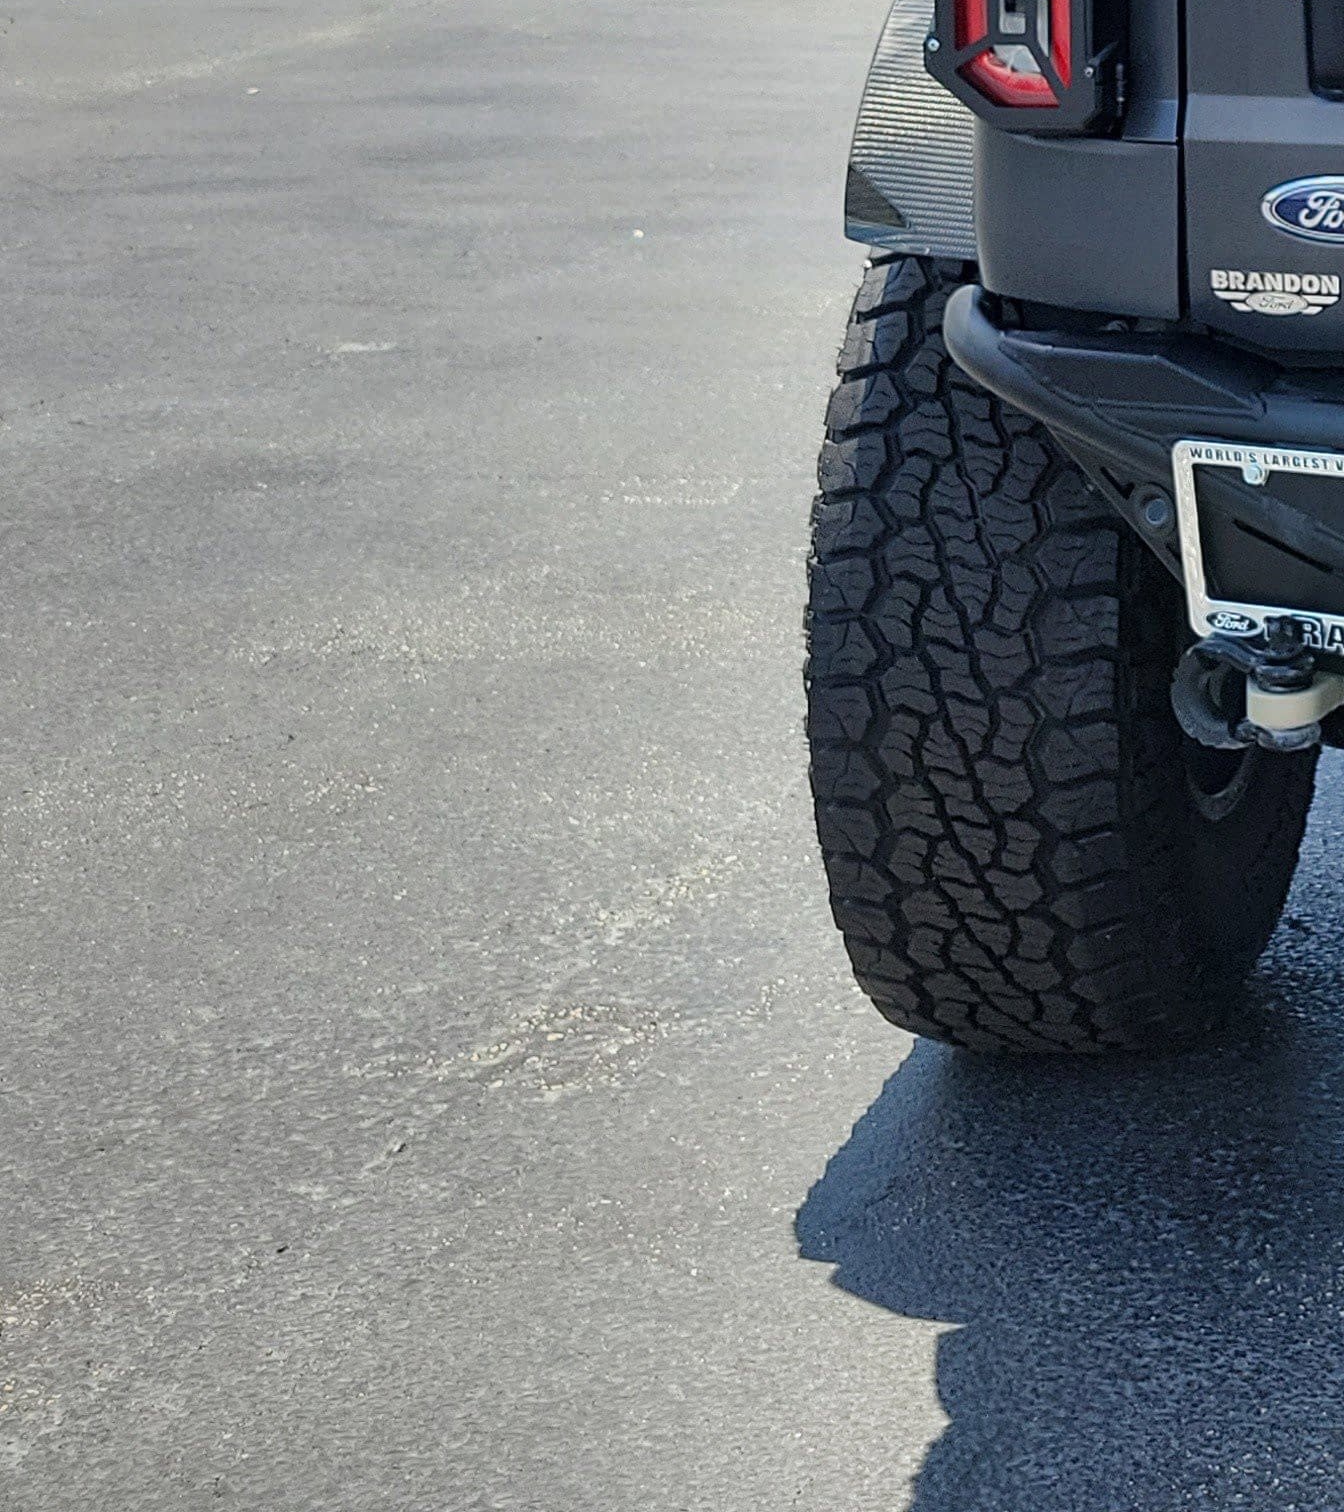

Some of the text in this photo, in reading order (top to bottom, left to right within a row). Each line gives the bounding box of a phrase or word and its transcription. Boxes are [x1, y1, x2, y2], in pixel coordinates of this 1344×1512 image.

[1211, 269, 1340, 295] BRANDON
[1189, 447, 1257, 463] WORLD'S
[1263, 453, 1328, 470] LARGEST
[1214, 611, 1252, 632] Ford
